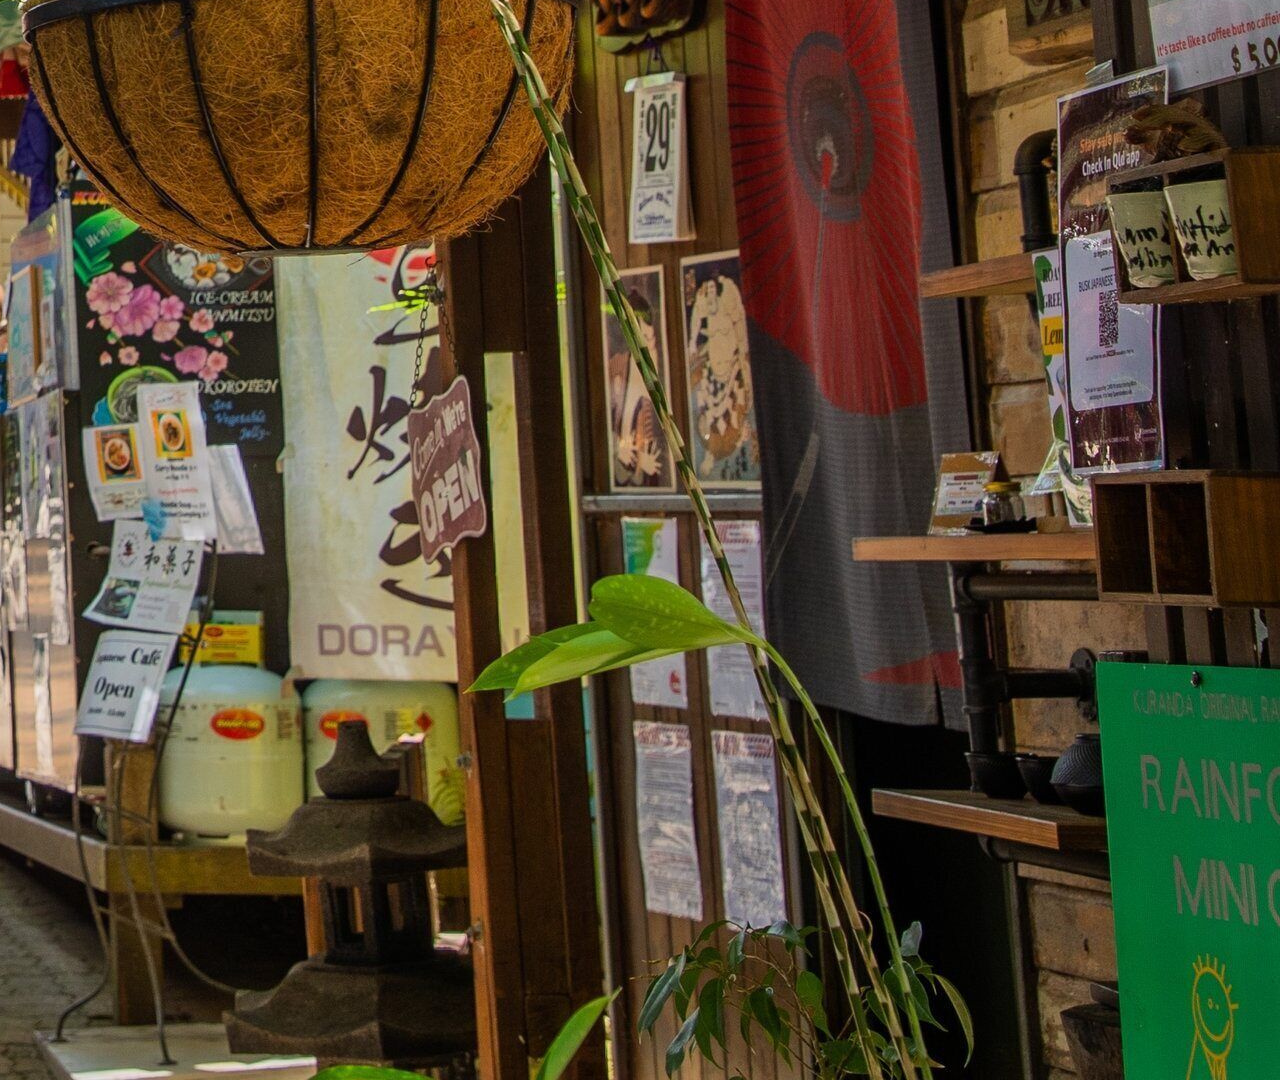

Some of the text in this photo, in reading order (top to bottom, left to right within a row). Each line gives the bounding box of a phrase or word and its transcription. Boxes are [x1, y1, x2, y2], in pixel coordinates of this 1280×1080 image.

[1156, 43, 1169, 57] It's
[1169, 40, 1187, 54] taste
[1186, 35, 1201, 48] like
[1207, 25, 1232, 42] coffee
[1231, 23, 1246, 36] but
[1246, 21, 1256, 32] no
[1247, 35, 1280, 70] 5.0
[644, 100, 671, 172] 29
[1082, 150, 1140, 177] Check In Qld app
[1091, 274, 1114, 289] JAPANESE
[190, 289, 274, 306] ICE-CREAM
[197, 378, 279, 395] OKOROTEN
[412, 430, 435, 481] Come
[441, 400, 466, 436] We're
[420, 449, 480, 543] OPEN
[131, 647, 162, 665] Café
[94, 676, 135, 700] Open
[1200, 692, 1257, 723] ORIGINAL
[1173, 855, 1259, 926] MINI
